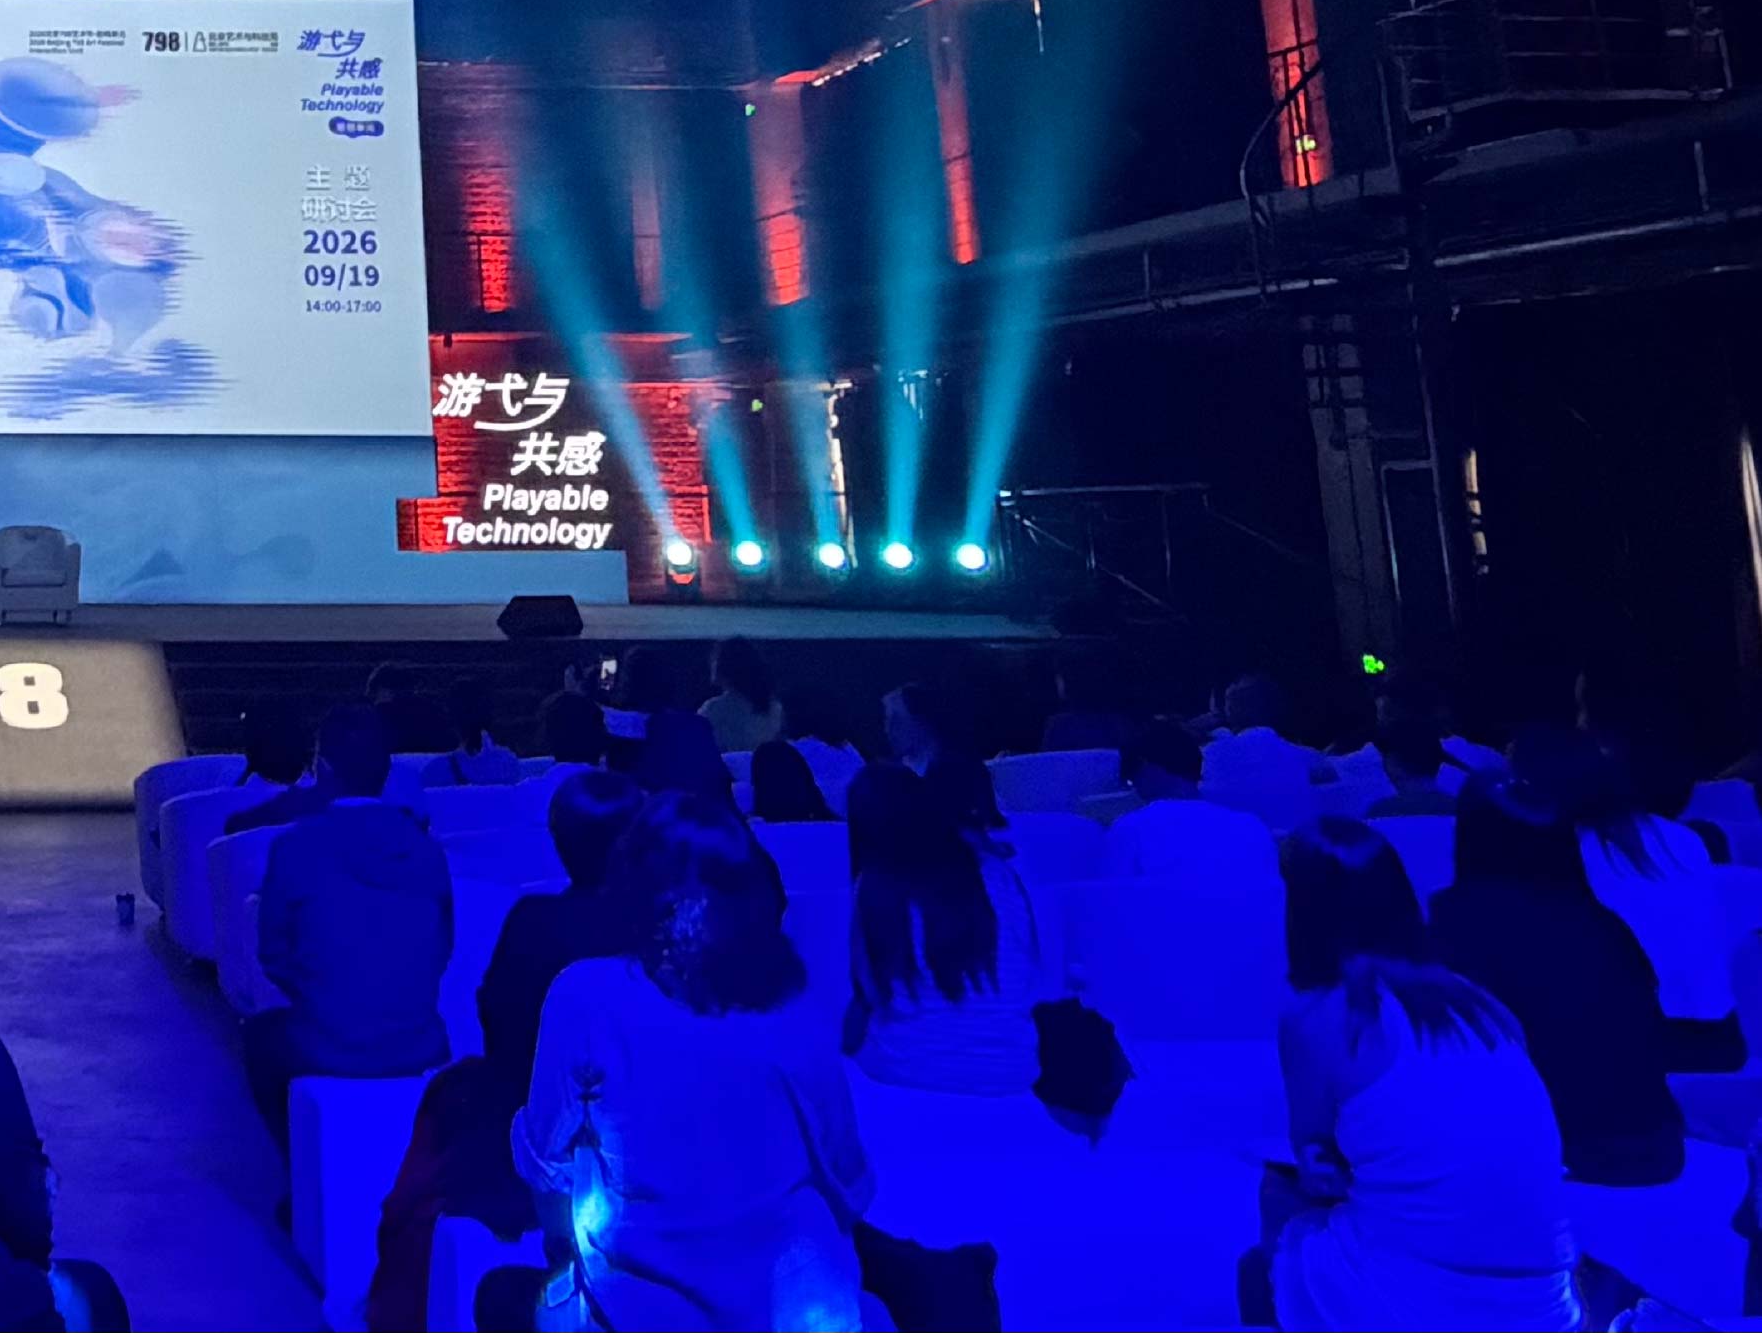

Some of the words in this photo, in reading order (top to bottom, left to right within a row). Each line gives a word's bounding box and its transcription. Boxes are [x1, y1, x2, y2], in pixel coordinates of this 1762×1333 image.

[142, 31, 180, 52] 798
[297, 29, 366, 57] 游弋与
[335, 57, 383, 79] 共感
[320, 83, 384, 98] Playable
[300, 98, 384, 114] Technology
[301, 195, 378, 223] 研讨会
[303, 229, 378, 255] 2026
[304, 263, 380, 291] 09/19
[306, 300, 382, 313] 14:00-17:00
[432, 372, 570, 431] 游弋与
[510, 431, 606, 476] 共感
[483, 483, 610, 516] Playable
[442, 517, 613, 550] Technology
